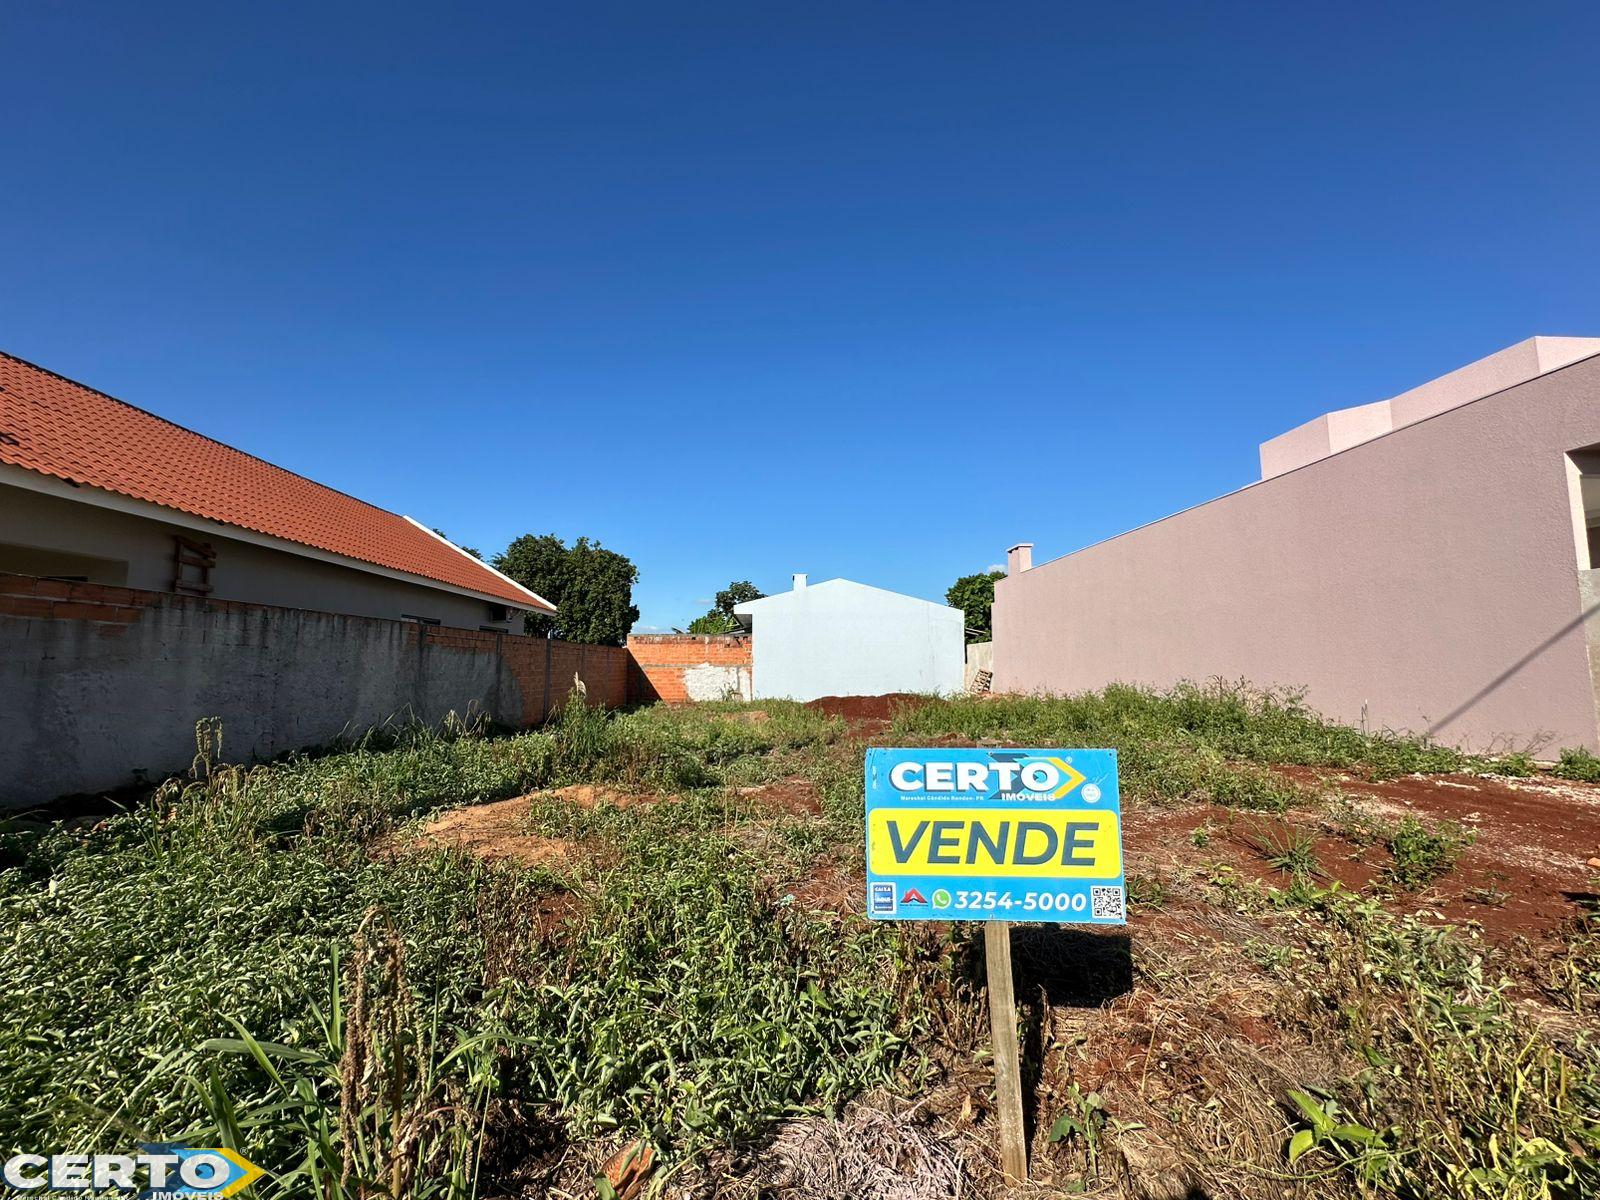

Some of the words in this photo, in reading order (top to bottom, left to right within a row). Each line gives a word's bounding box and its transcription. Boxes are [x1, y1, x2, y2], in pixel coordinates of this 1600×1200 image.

[889, 761, 1060, 792] CERTO
[886, 820, 1100, 866] VENDE
[954, 890, 1087, 911] 3254-5000
